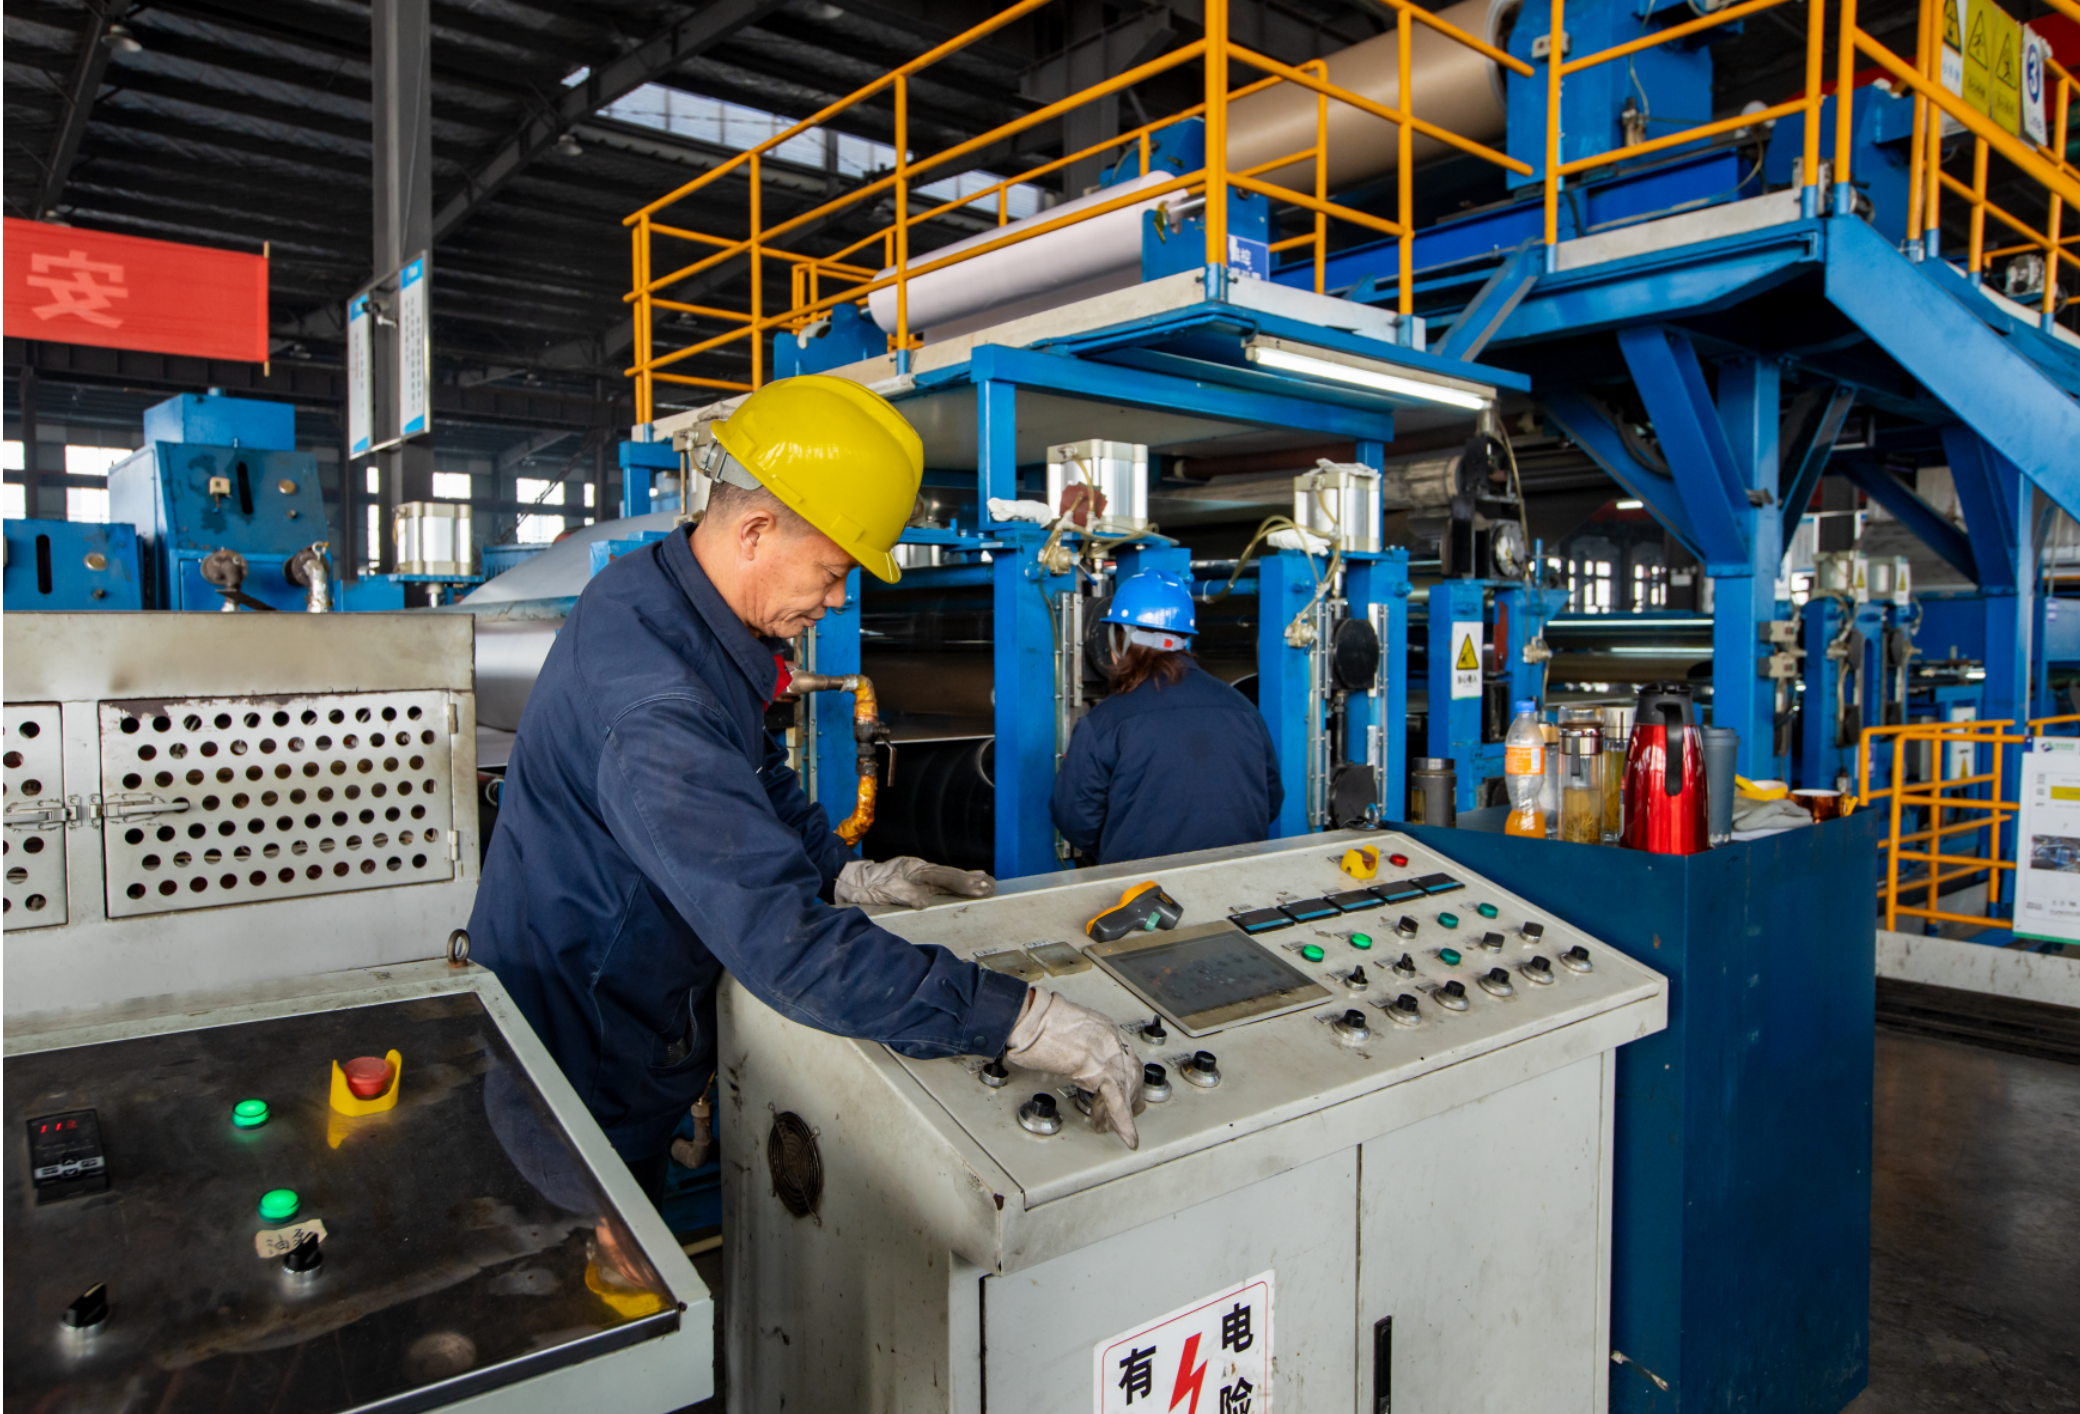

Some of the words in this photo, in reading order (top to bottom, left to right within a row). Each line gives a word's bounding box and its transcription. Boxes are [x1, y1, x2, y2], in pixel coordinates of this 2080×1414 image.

[1118, 1345, 1157, 1406] 有
[1222, 1302, 1254, 1353] 电
[1220, 1377, 1254, 1414] 险
